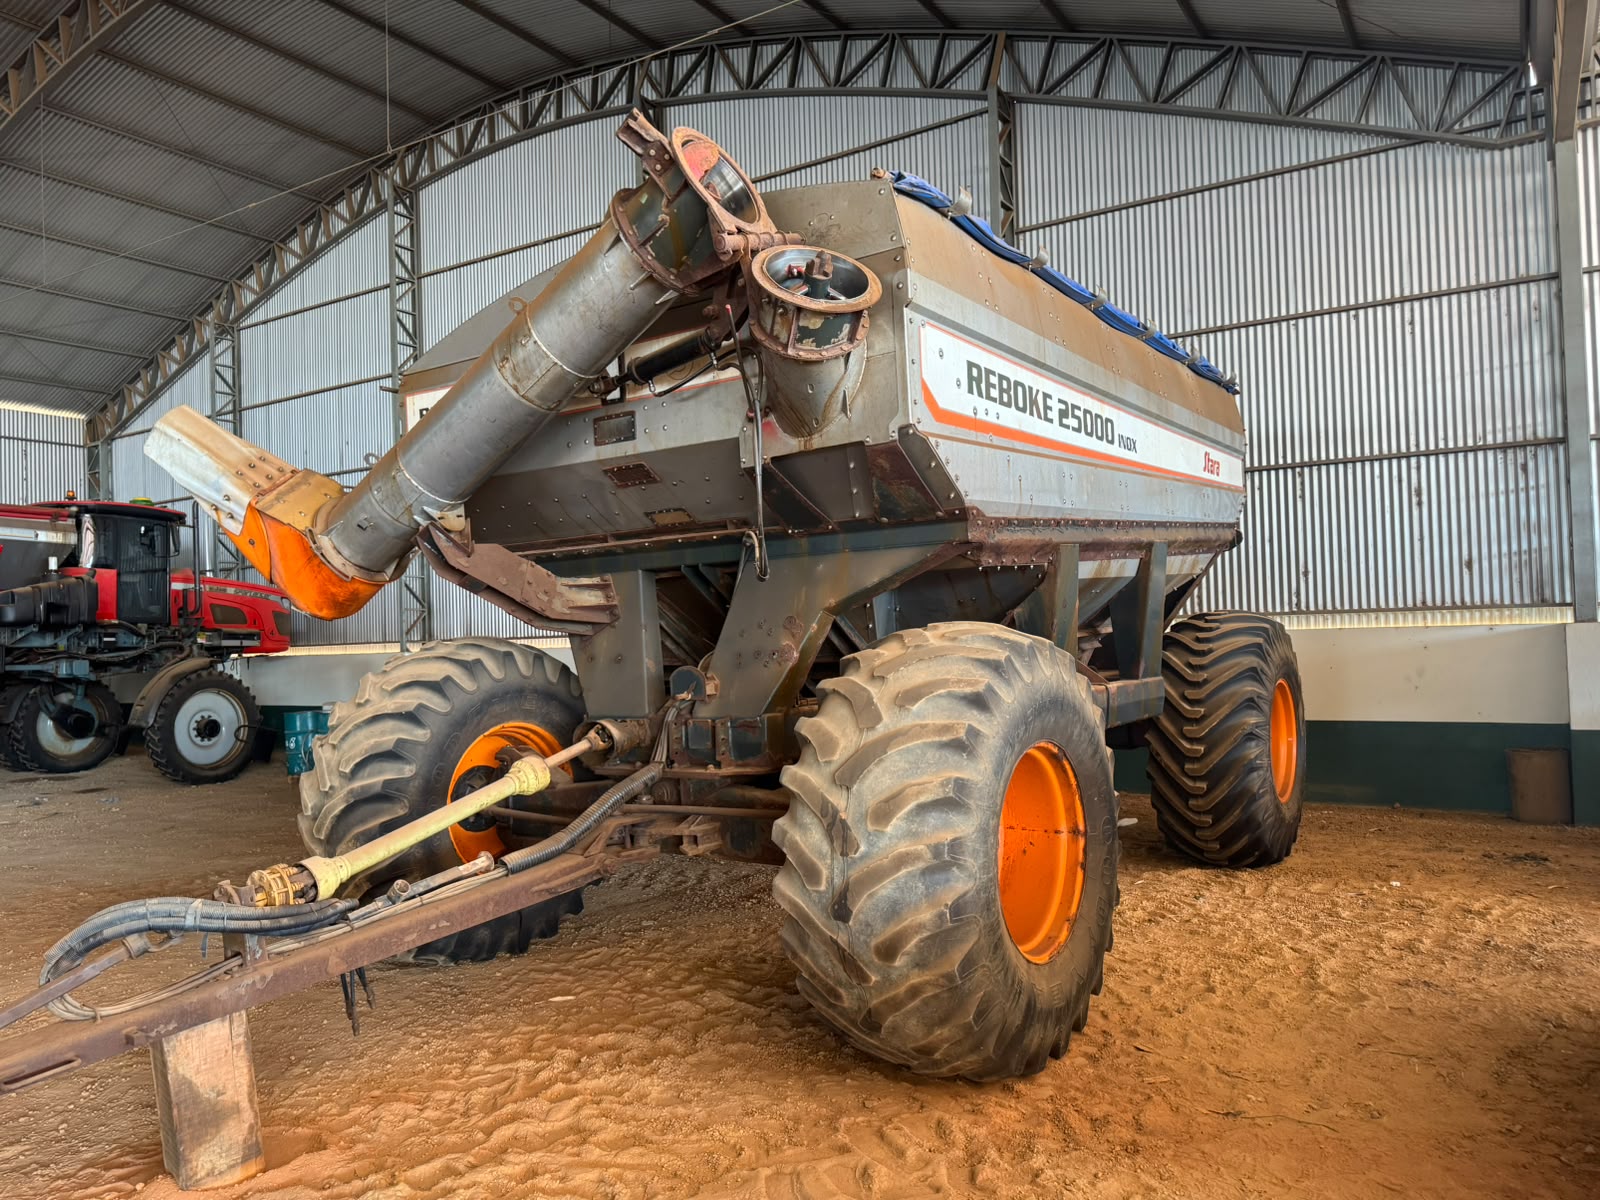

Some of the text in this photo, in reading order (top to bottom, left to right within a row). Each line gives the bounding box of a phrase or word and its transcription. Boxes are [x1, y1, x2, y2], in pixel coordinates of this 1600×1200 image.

[966, 359, 1137, 453] REBOKE 25000 INOX
[1203, 451, 1220, 476] Stara
